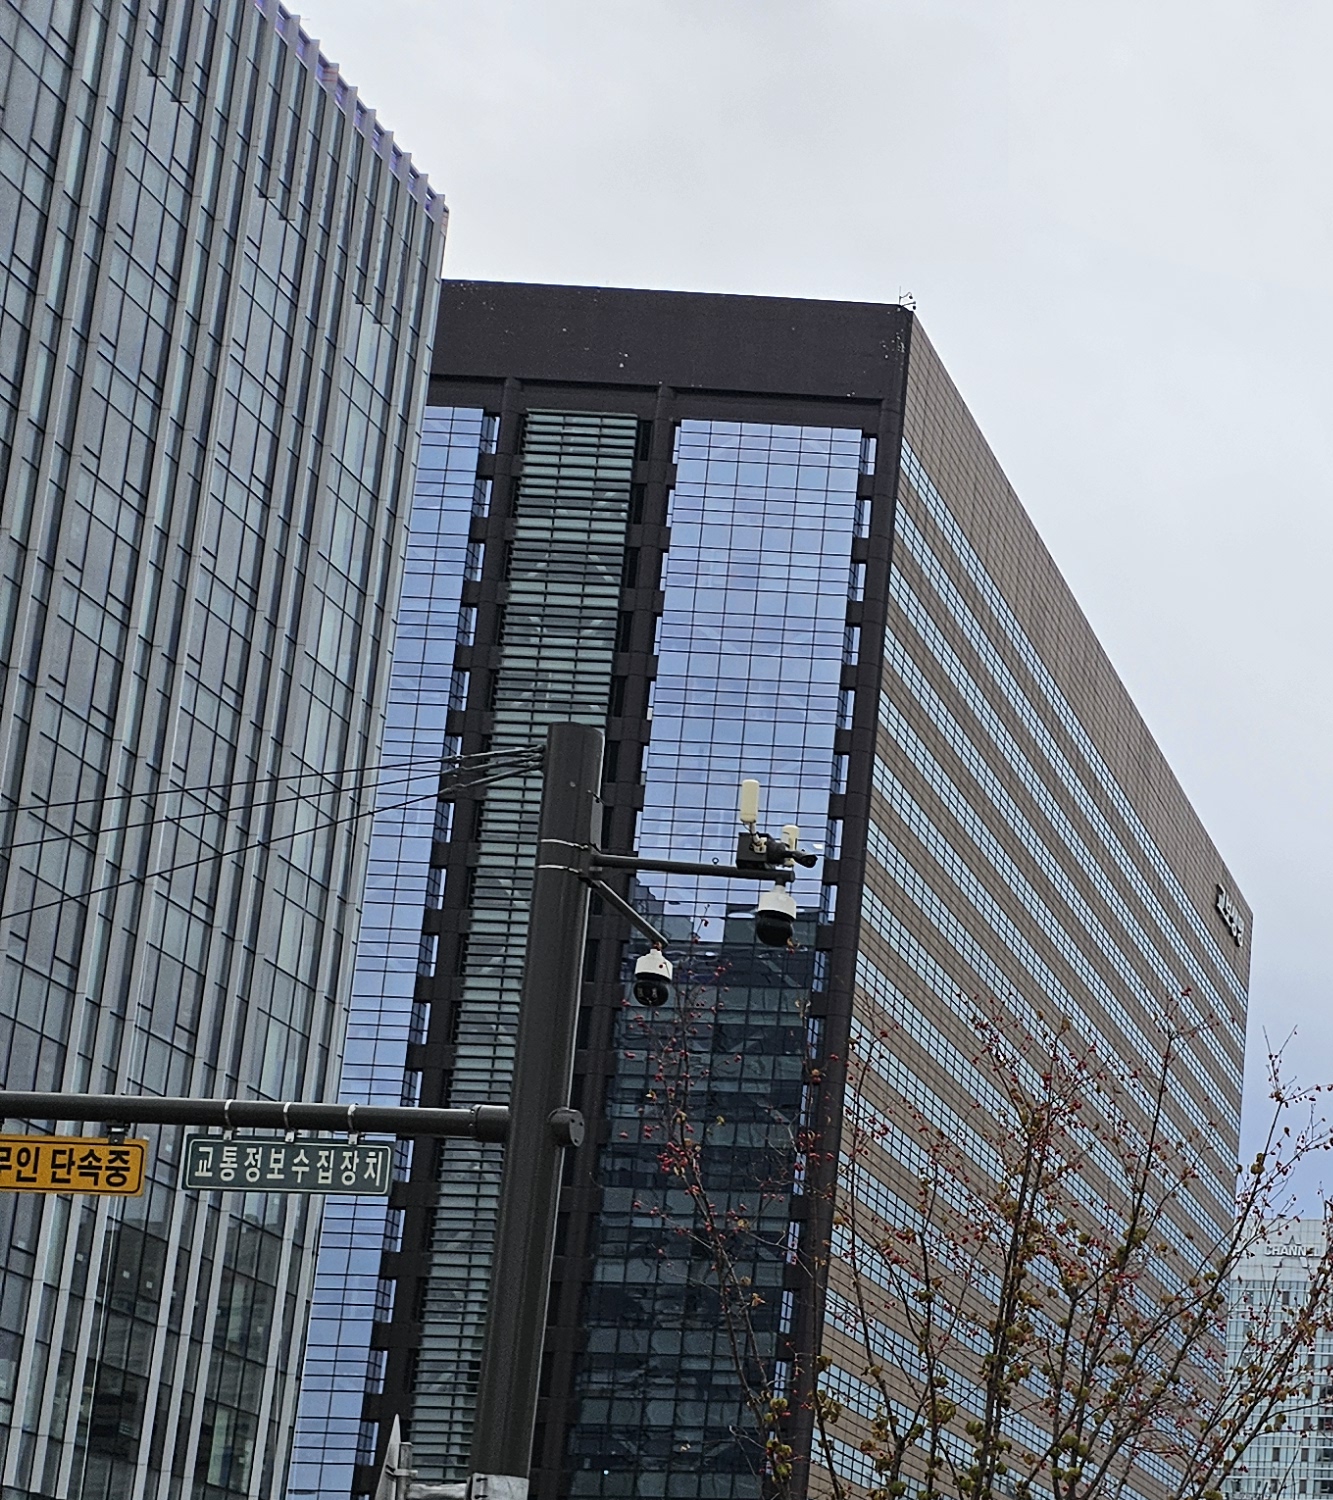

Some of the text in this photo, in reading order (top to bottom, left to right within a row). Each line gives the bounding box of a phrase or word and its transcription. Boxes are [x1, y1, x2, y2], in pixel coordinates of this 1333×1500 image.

[51, 1148, 131, 1187] 단속중
[194, 1146, 382, 1187] 교통정보수집장치
[1264, 1245, 1320, 1257] CHANNL
